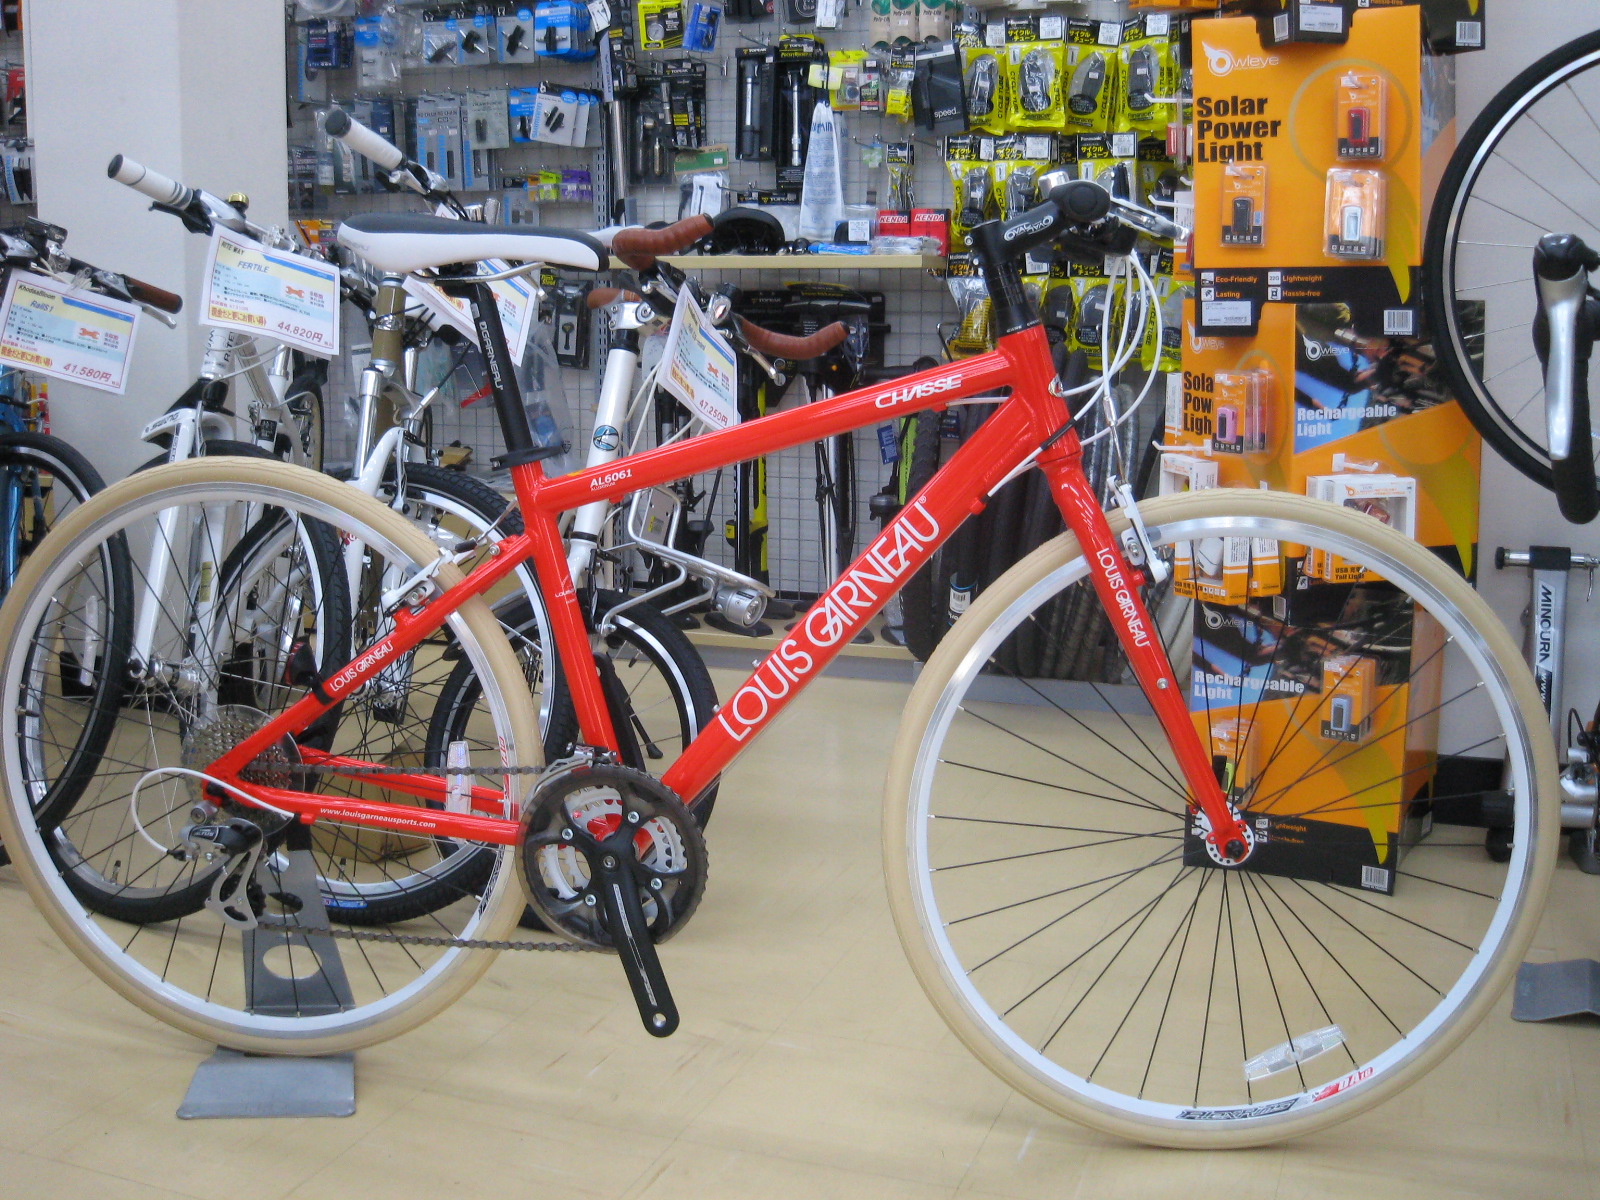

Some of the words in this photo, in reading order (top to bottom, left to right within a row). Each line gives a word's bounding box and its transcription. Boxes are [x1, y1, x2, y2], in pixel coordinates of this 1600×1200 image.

[1197, 96, 1268, 118] Solar
[1197, 120, 1281, 140] Power
[1197, 141, 1263, 164] Light
[880, 215, 908, 223] KENDA
[914, 213, 944, 221] KENDA
[238, 260, 270, 273] FERTILE
[1215, 275, 1257, 284] Eco-Friendly
[1283, 275, 1322, 283] Lightweight
[1215, 291, 1240, 299] Lasting
[875, 374, 962, 408] CHASSE
[1184, 371, 1214, 393] Sola
[1184, 392, 1214, 414] Pow
[1297, 404, 1397, 421] Rechargeable
[1184, 413, 1213, 435] Ligh
[1297, 422, 1332, 437] Light
[590, 468, 632, 488] AL6061
[1096, 547, 1124, 590] LOUIS
[1115, 589, 1151, 647] GARNEAU
[718, 639, 814, 742] LOUIS
[805, 500, 941, 647] GARNEAU
[330, 667, 357, 692] LOUIS
[355, 640, 394, 673] GARNEAU
[1194, 684, 1233, 699] Light
[1195, 671, 1305, 693] Rechargeable
[320, 807, 437, 829] www.louisgarneausports.com
